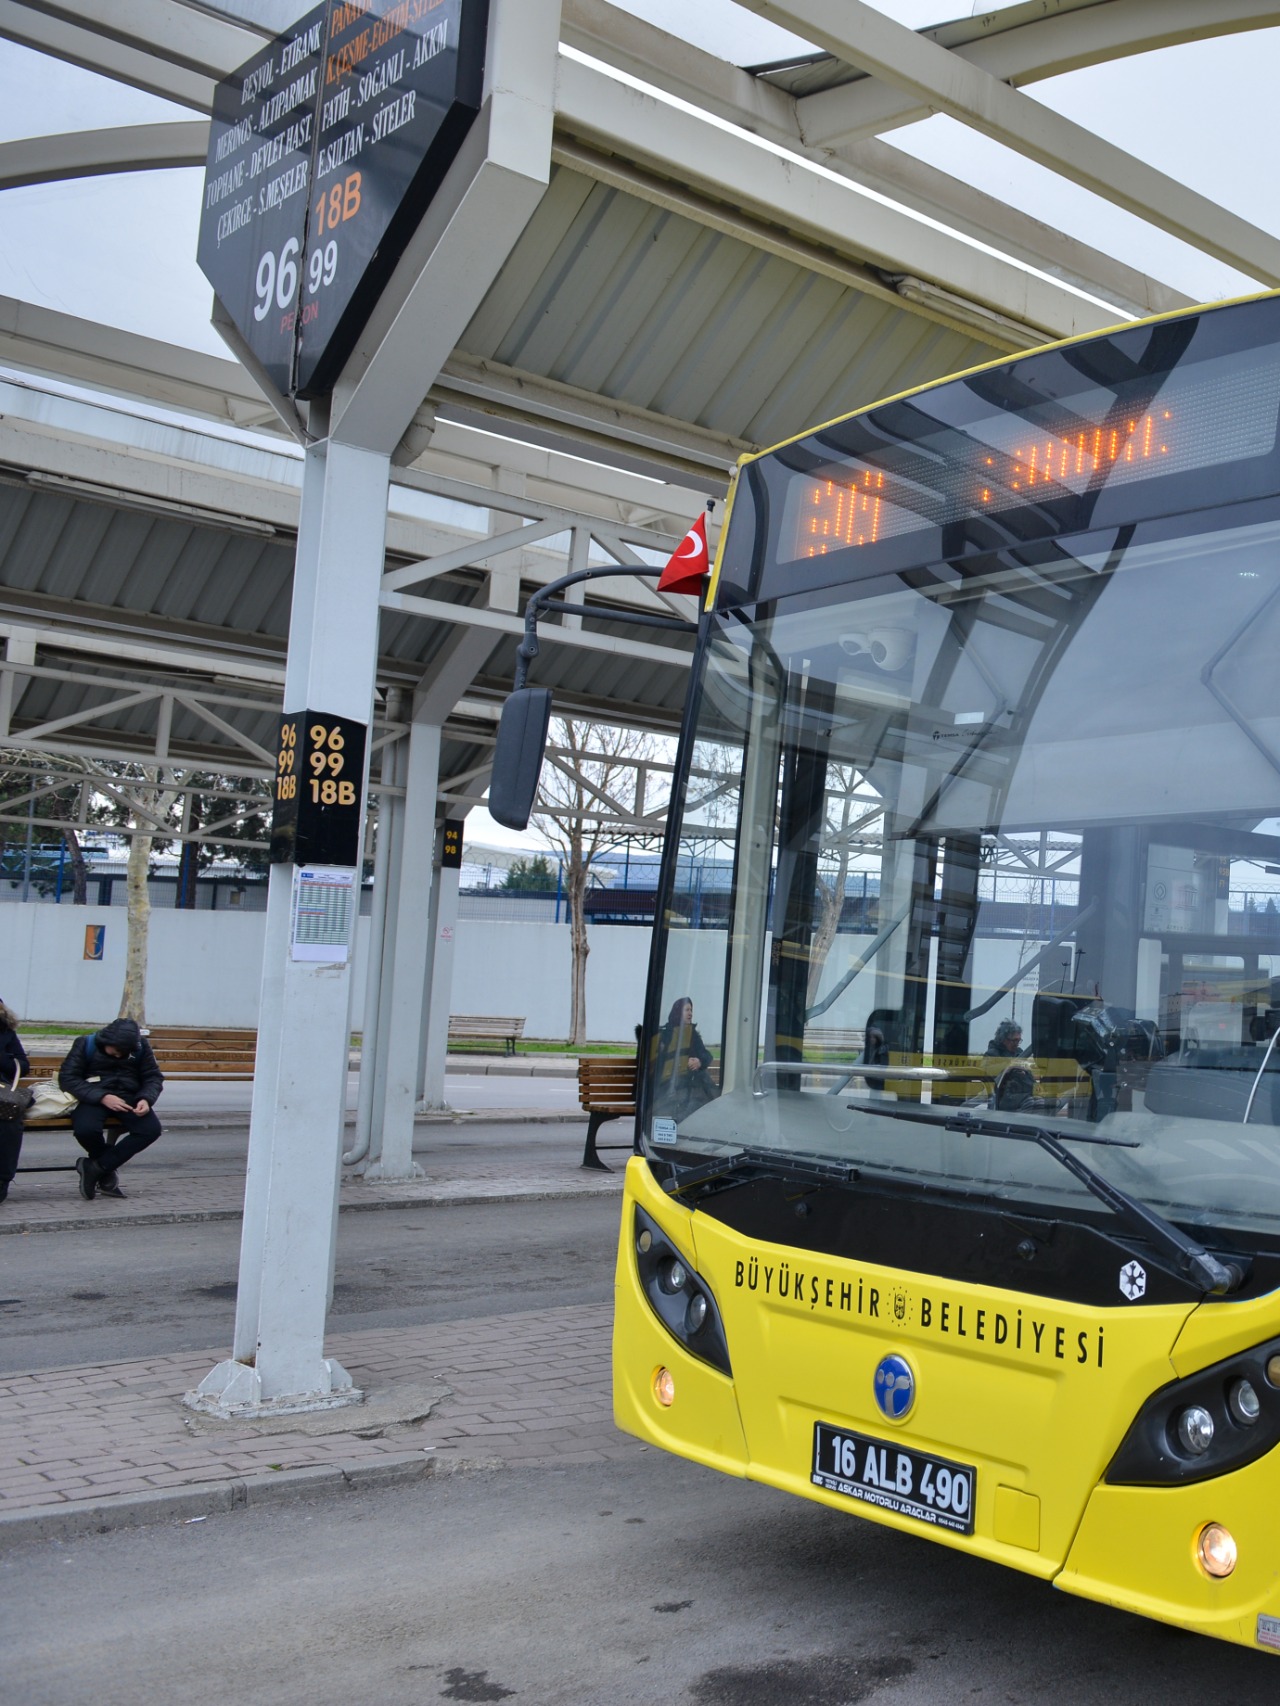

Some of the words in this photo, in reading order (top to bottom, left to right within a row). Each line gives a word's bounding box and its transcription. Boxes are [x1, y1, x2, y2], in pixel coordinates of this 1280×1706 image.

[241, 58, 275, 106] BEŞYOL
[280, 20, 323, 77] ETİBANK
[321, 85, 350, 132] FATİH
[357, 49, 405, 108] SOĞANLI
[412, 18, 449, 71] AKKM
[215, 115, 254, 164] MERİNOS
[258, 66, 318, 136] ALTIPARMAK
[317, 130, 364, 180] E.SULTAN
[371, 90, 417, 144] SİTELER
[206, 164, 245, 210] TOPHANE
[250, 134, 285, 181] DEVLET
[285, 114, 312, 160] HAST.
[216, 197, 252, 248] ÇEKİRGE
[258, 160, 309, 219] S.MEŞELER
[315, 170, 362, 238] 18B
[253, 236, 299, 322] 96
[308, 240, 338, 295] 99
[280, 300, 319, 335] PEON
[278, 749, 294, 774] 99
[281, 723, 297, 748] 96
[309, 724, 345, 750] 96
[309, 751, 344, 777] 99
[276, 774, 296, 800] 18B
[309, 778, 356, 806] 18B
[735, 1257, 881, 1319] BÜYÜKŞEHİR
[921, 1298, 1105, 1369] BELEDİYESİ
[832, 1435, 856, 1477] 16
[862, 1445, 913, 1496] ALB
[919, 1463, 969, 1514] 490
[838, 1482, 863, 1499] ASKAR
[864, 1490, 900, 1511] MOTORLU
[900, 1503, 937, 1523] ARAÇLAR
